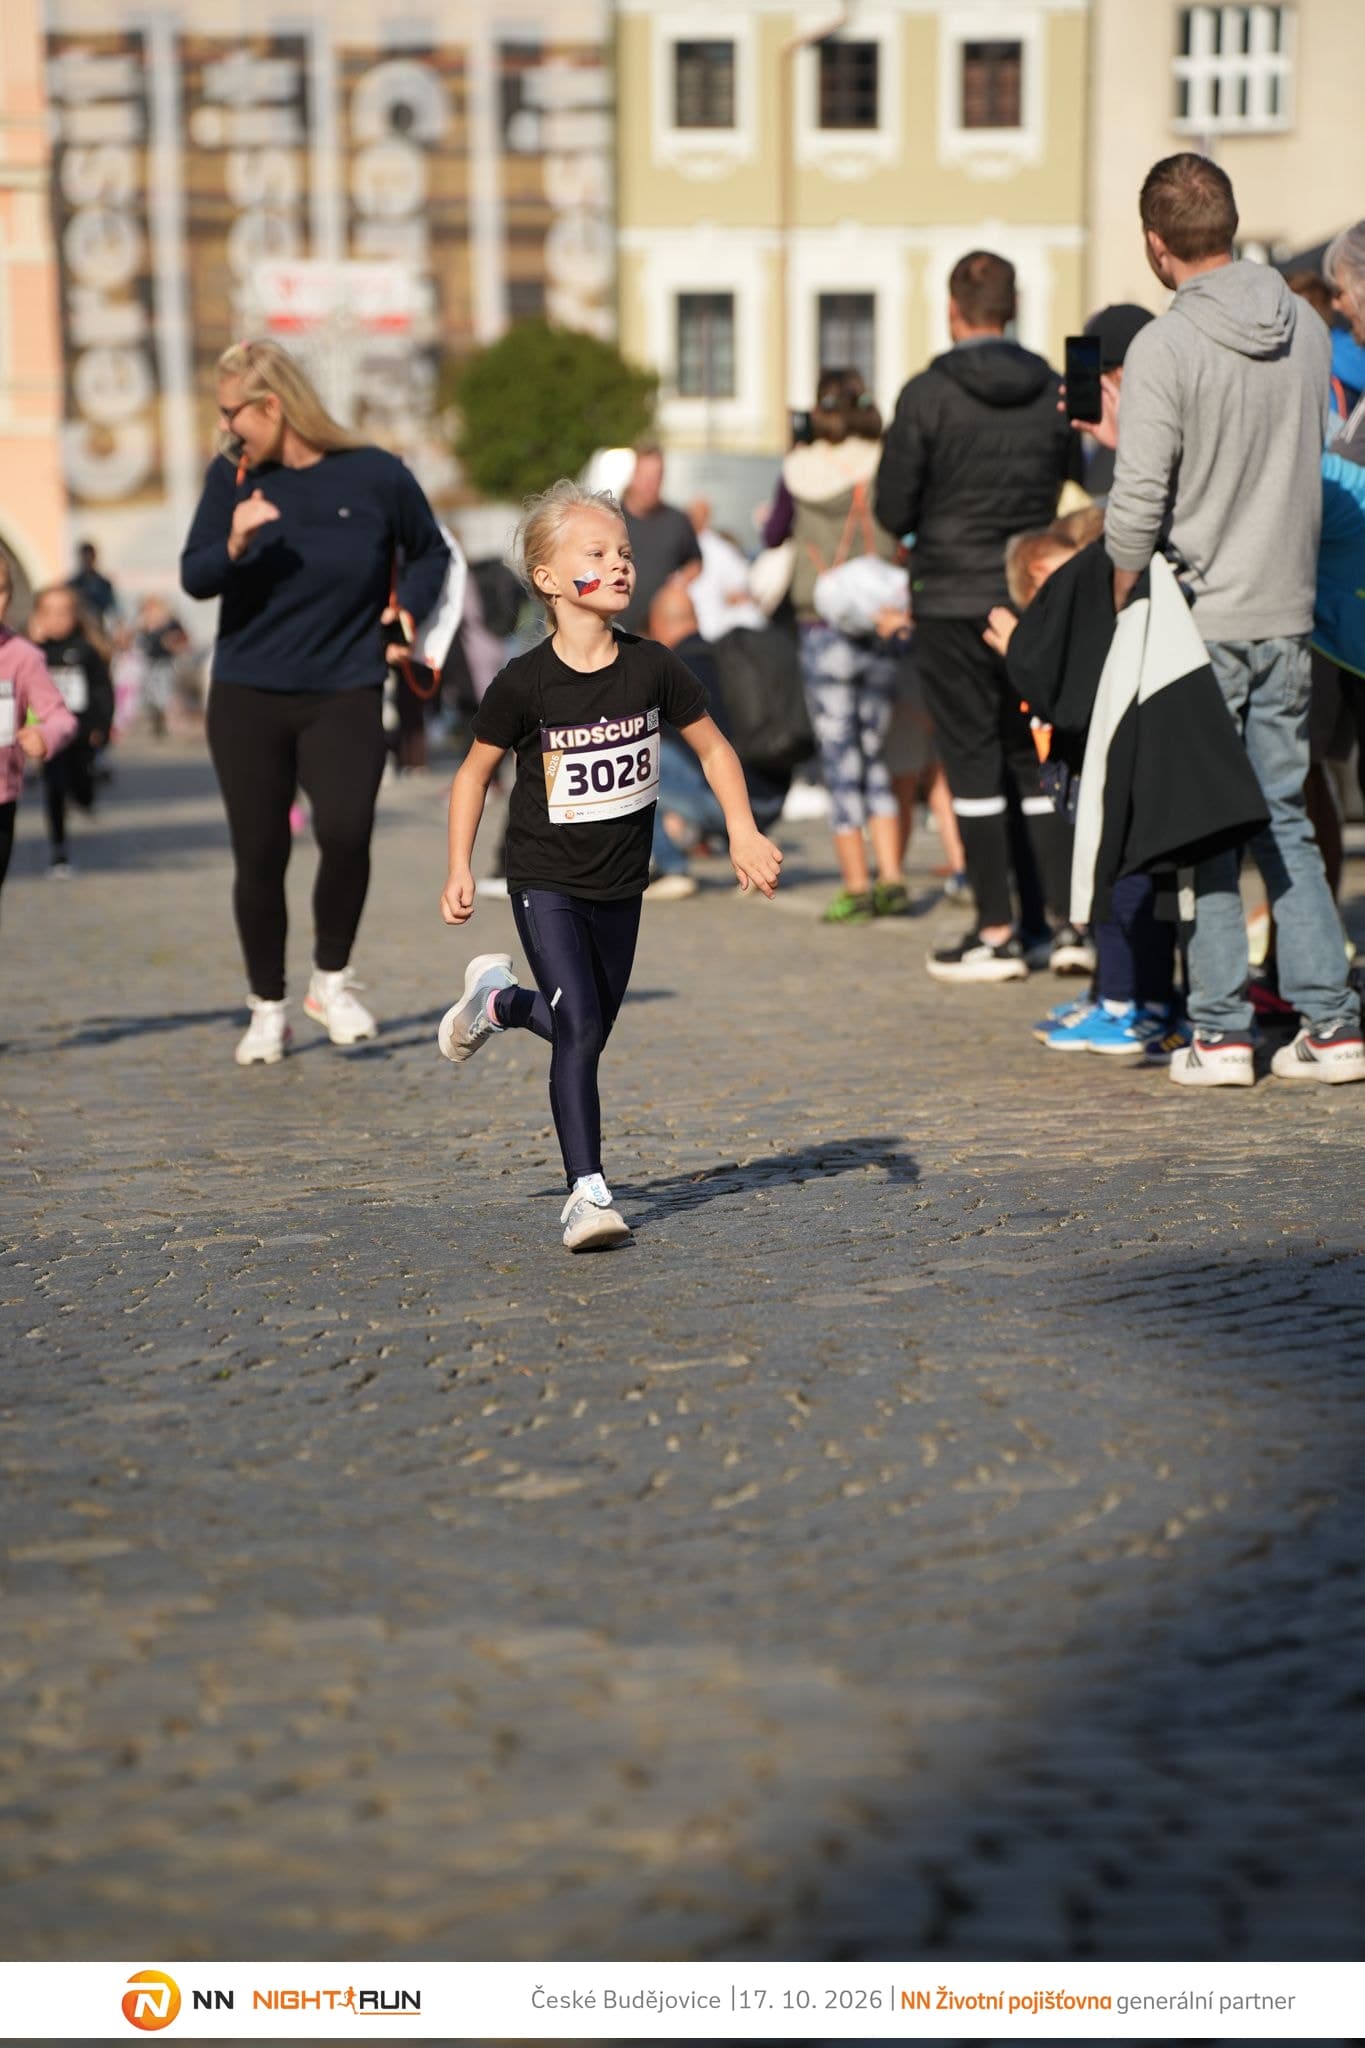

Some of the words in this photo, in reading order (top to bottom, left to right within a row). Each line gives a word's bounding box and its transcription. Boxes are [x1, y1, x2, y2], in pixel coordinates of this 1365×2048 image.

[550, 716, 645, 749] KIDSCUP
[545, 754, 560, 777] 2026
[566, 747, 651, 796] 3028
